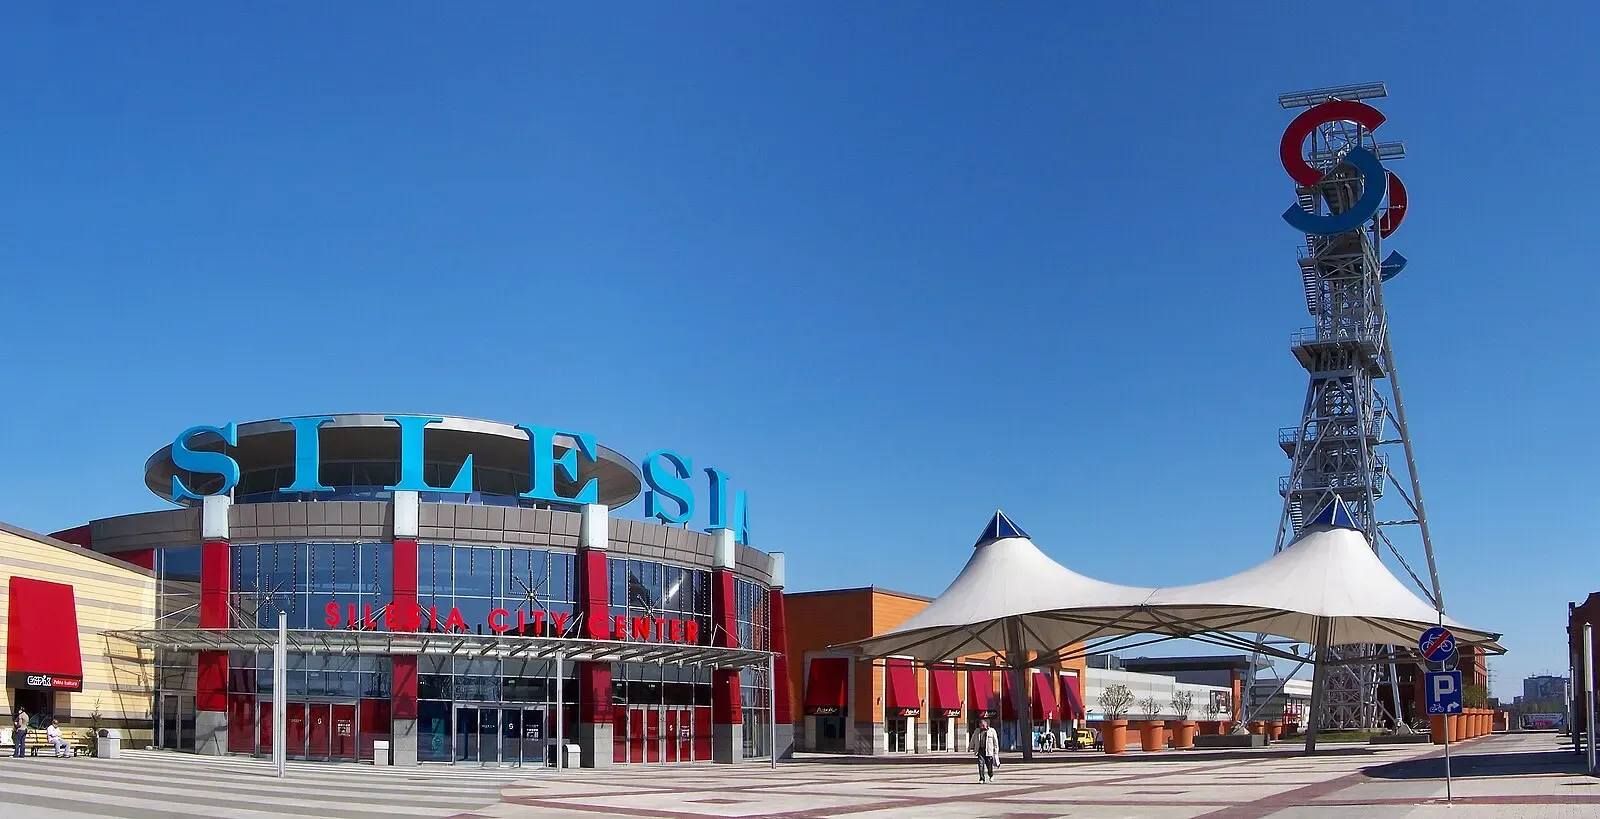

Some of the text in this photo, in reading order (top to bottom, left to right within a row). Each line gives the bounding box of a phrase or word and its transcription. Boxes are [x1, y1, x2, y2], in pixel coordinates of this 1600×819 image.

[171, 415, 751, 546] SILESIA
[324, 601, 699, 644] SILESIA CITY CENTER
[1433, 675, 1454, 702] P
